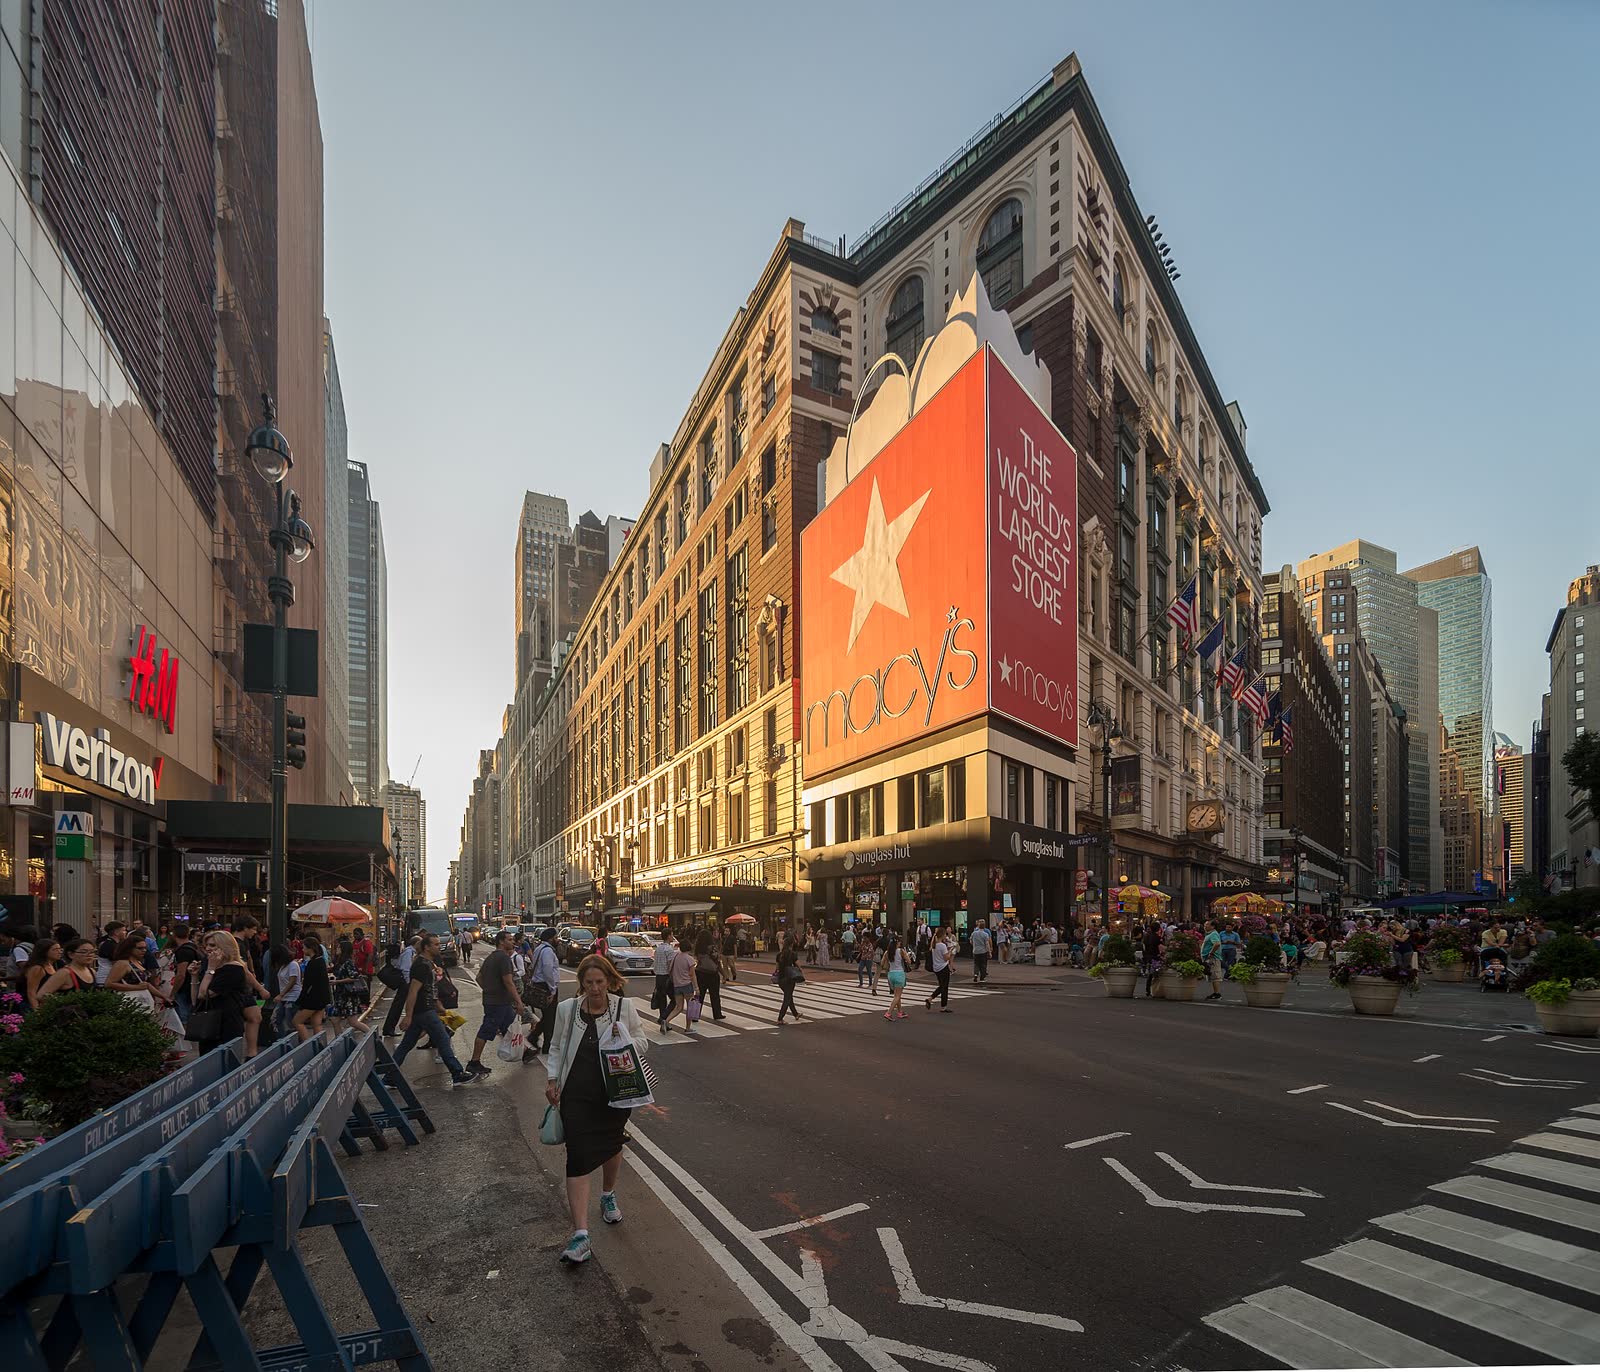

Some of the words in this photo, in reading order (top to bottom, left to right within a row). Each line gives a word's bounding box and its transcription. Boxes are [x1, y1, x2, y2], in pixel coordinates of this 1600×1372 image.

[1020, 428, 1052, 495] THE
[997, 448, 1071, 553] WORLD'S
[999, 495, 1070, 588] LARGEST
[1012, 554, 1062, 625] STORE
[128, 624, 180, 735] H&M
[806, 606, 978, 755] macy's
[1014, 658, 1073, 723] macy's
[43, 712, 155, 806] verizon
[11, 787, 34, 800] H&M
[187, 863, 205, 871] WE
[206, 855, 243, 864] verizon
[855, 847, 892, 867] sunglass
[894, 843, 911, 859] hut
[1022, 838, 1052, 859] sunglass
[1053, 841, 1064, 858] hut
[1215, 877, 1250, 889] macy's
[85, 1115, 118, 1155] POLICE
[125, 1101, 142, 1128] LINE
[161, 1106, 190, 1144] POLICE
[195, 1093, 211, 1119] LINE
[226, 1096, 247, 1129] POLICE
[249, 1084, 261, 1109] LINE
